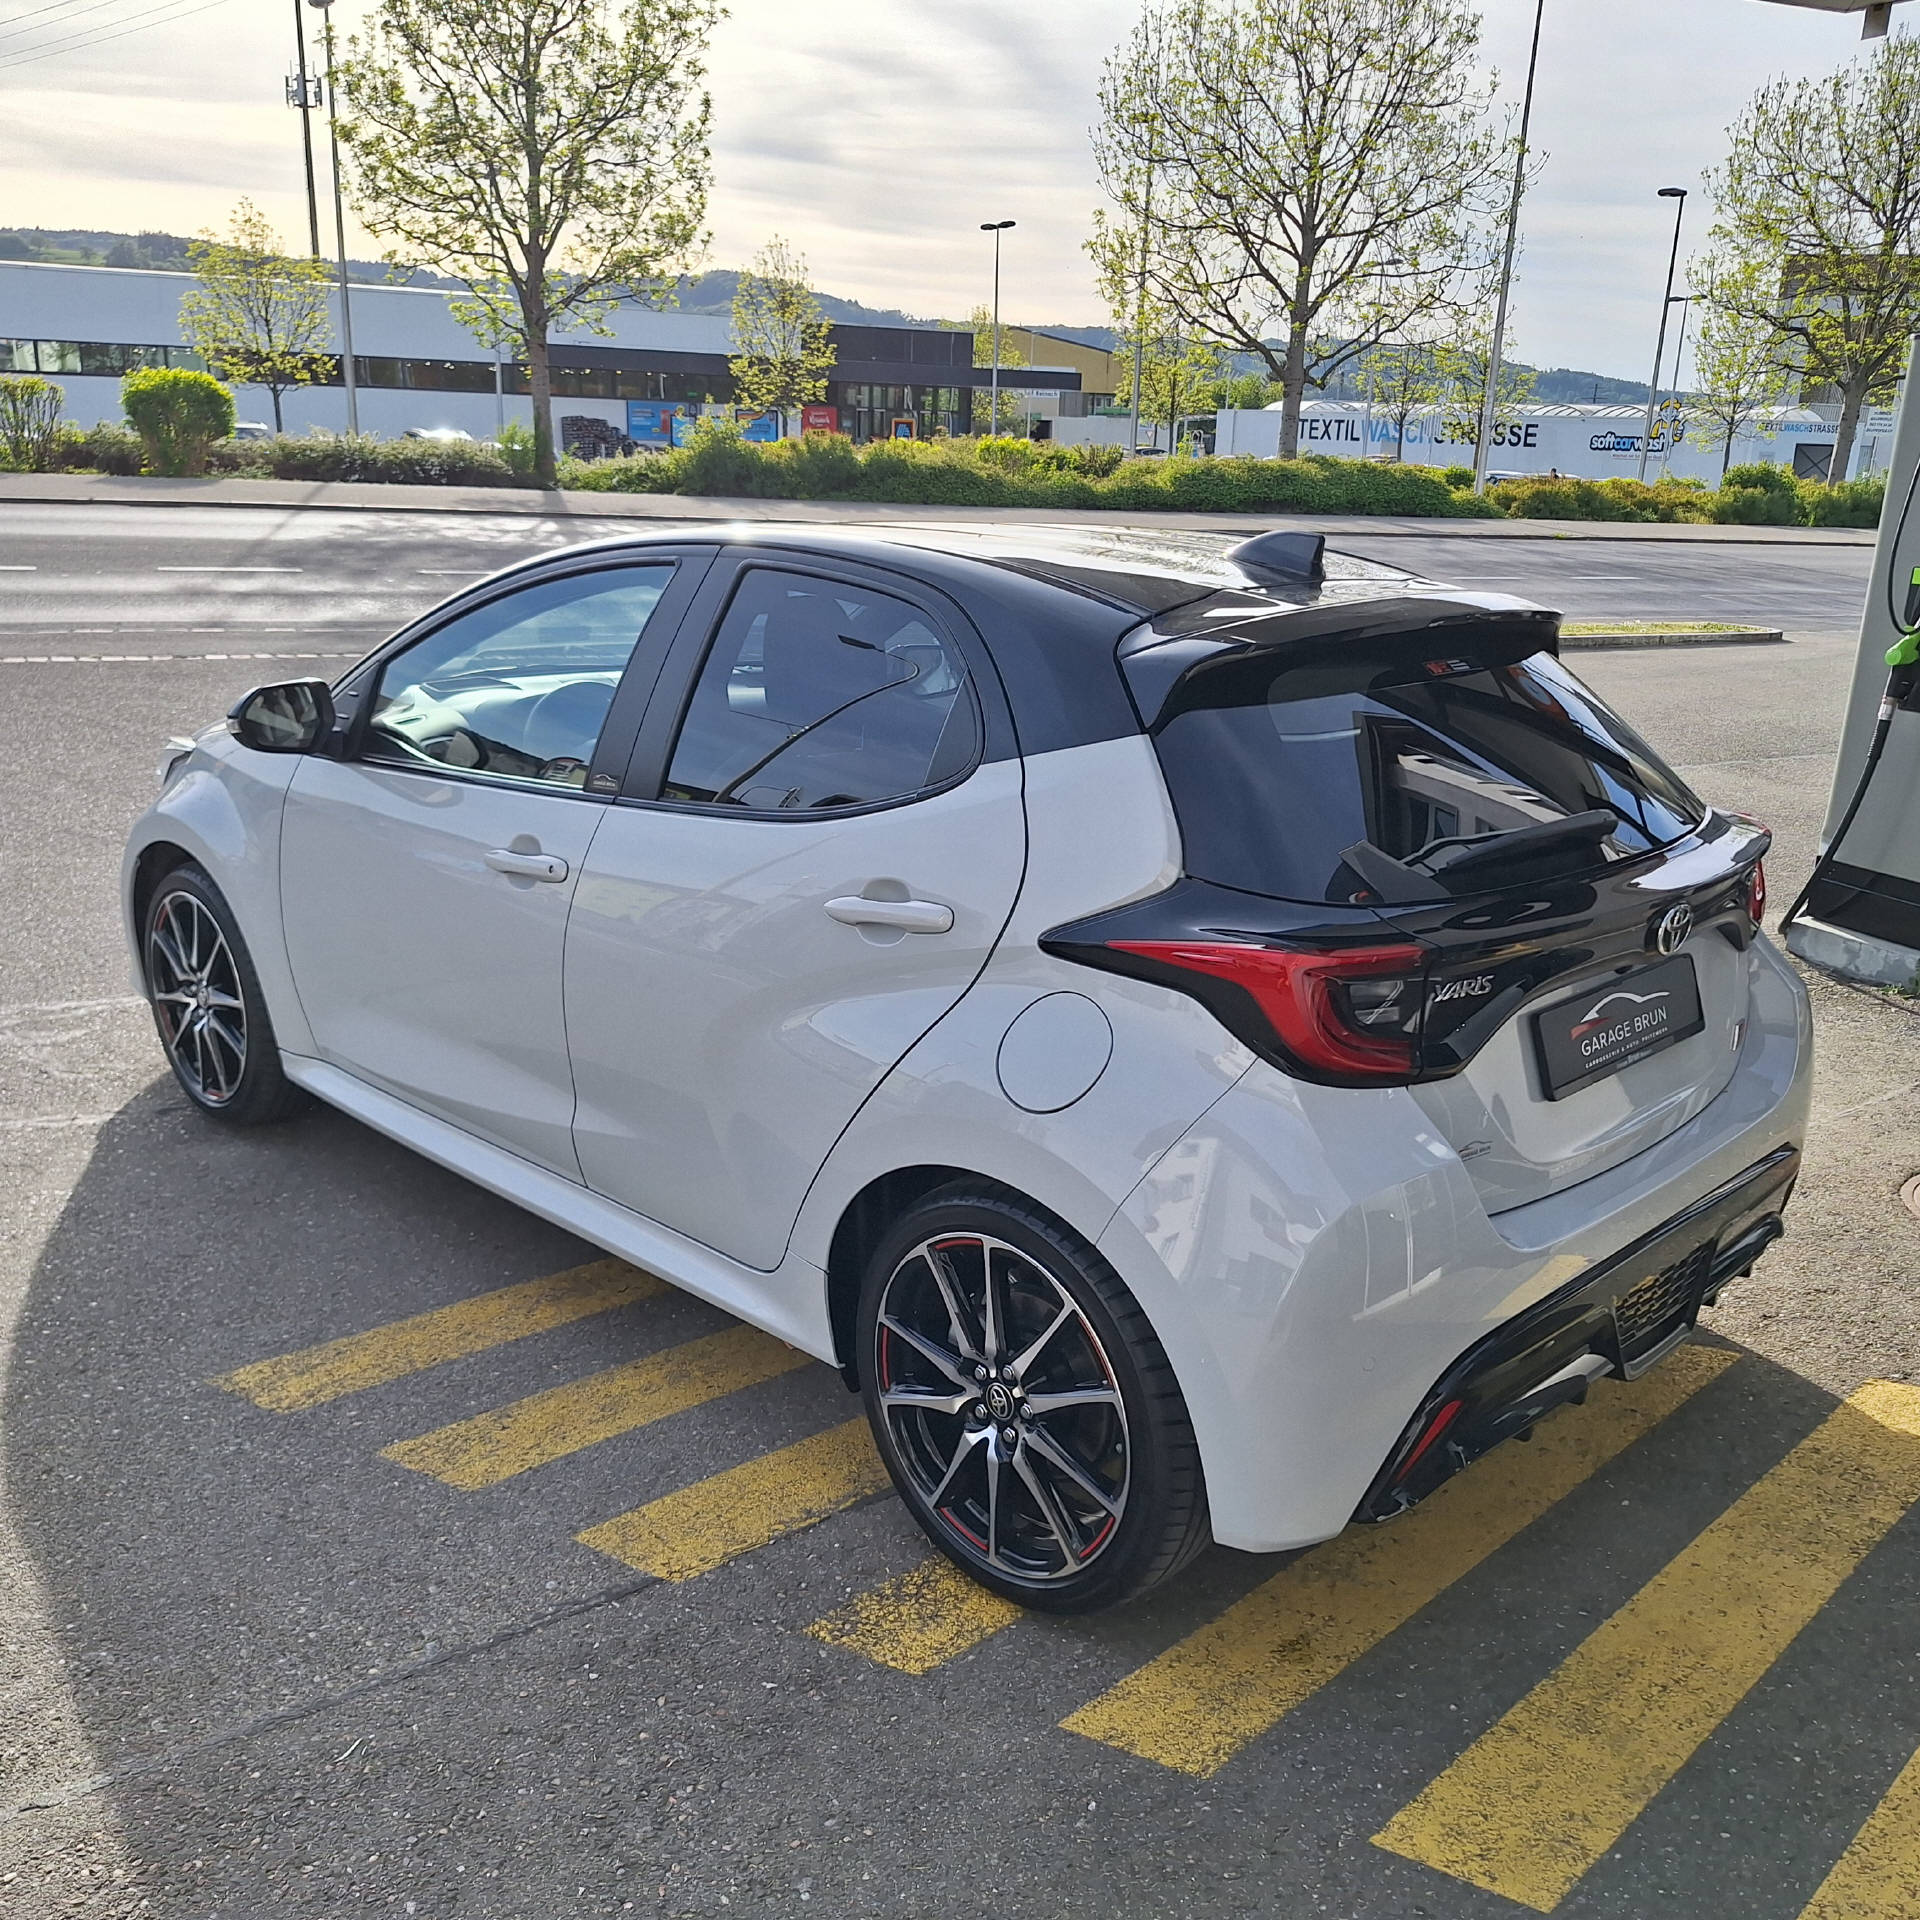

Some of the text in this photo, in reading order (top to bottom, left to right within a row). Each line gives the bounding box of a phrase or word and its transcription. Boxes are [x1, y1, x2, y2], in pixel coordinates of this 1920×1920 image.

[1434, 975, 1495, 1002] YARIS
[1581, 1005, 1667, 1056] GARAGE BRUN
